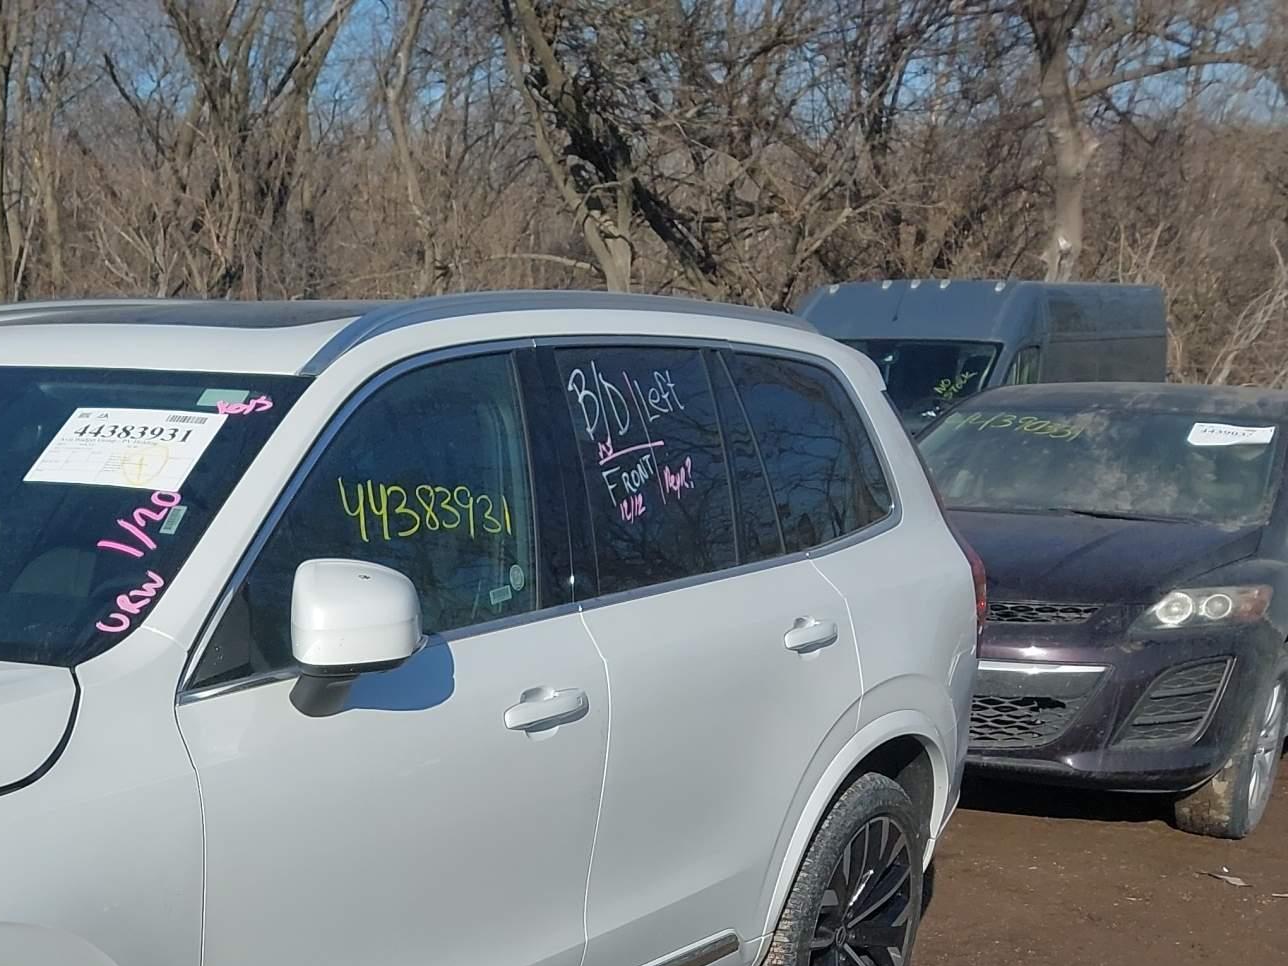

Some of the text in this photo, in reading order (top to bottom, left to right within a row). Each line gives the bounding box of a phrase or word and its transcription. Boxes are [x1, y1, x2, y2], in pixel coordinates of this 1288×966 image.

[634, 370, 684, 422] Left
[74, 423, 192, 443] 44383931
[602, 454, 654, 507] FRONT
[97, 490, 181, 557] 1/20
[338, 477, 511, 542] 44383931
